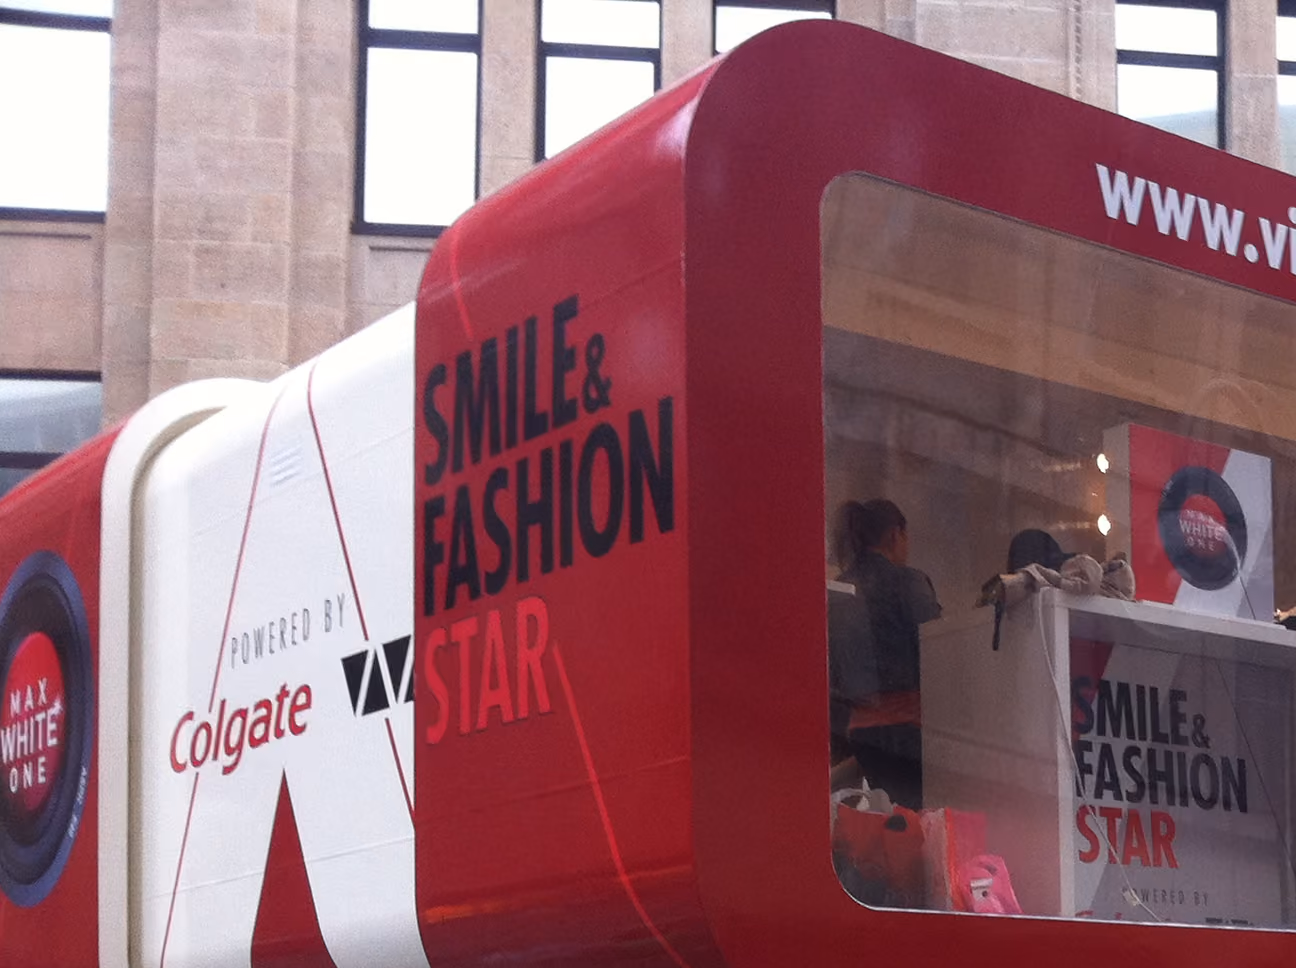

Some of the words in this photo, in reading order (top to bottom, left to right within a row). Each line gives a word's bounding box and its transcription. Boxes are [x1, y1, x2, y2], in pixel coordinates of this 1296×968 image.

[423, 396, 675, 618] FASHION
[231, 608, 310, 669] POWERED
[324, 593, 345, 633] BY
[10, 677, 48, 718] MAX
[424, 595, 551, 746] STAR
[0, 707, 58, 764] WHITE
[169, 682, 312, 776] Colgate
[9, 756, 47, 793] ONE
[1073, 740, 1248, 813] FASHION
[1074, 805, 1180, 869] STAR
